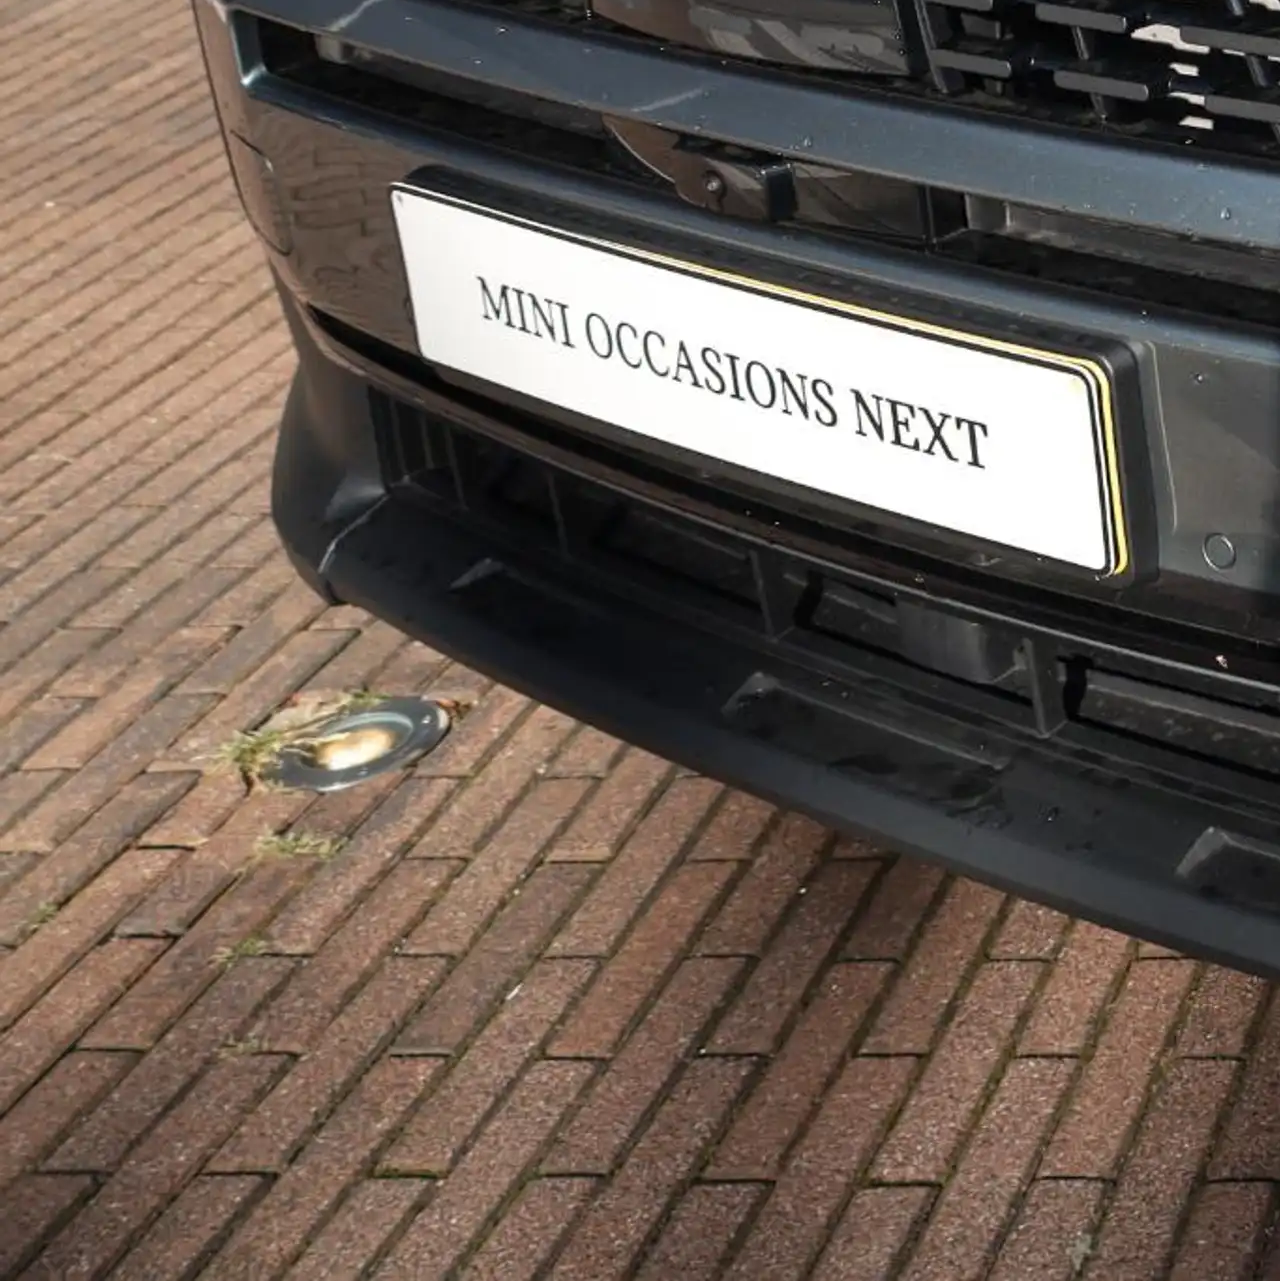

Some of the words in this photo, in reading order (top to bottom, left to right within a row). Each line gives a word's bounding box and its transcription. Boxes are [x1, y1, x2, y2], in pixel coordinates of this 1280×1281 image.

[474, 276, 577, 350] MINI
[584, 310, 838, 429] OCCASIONS
[851, 389, 989, 470] NEXT
